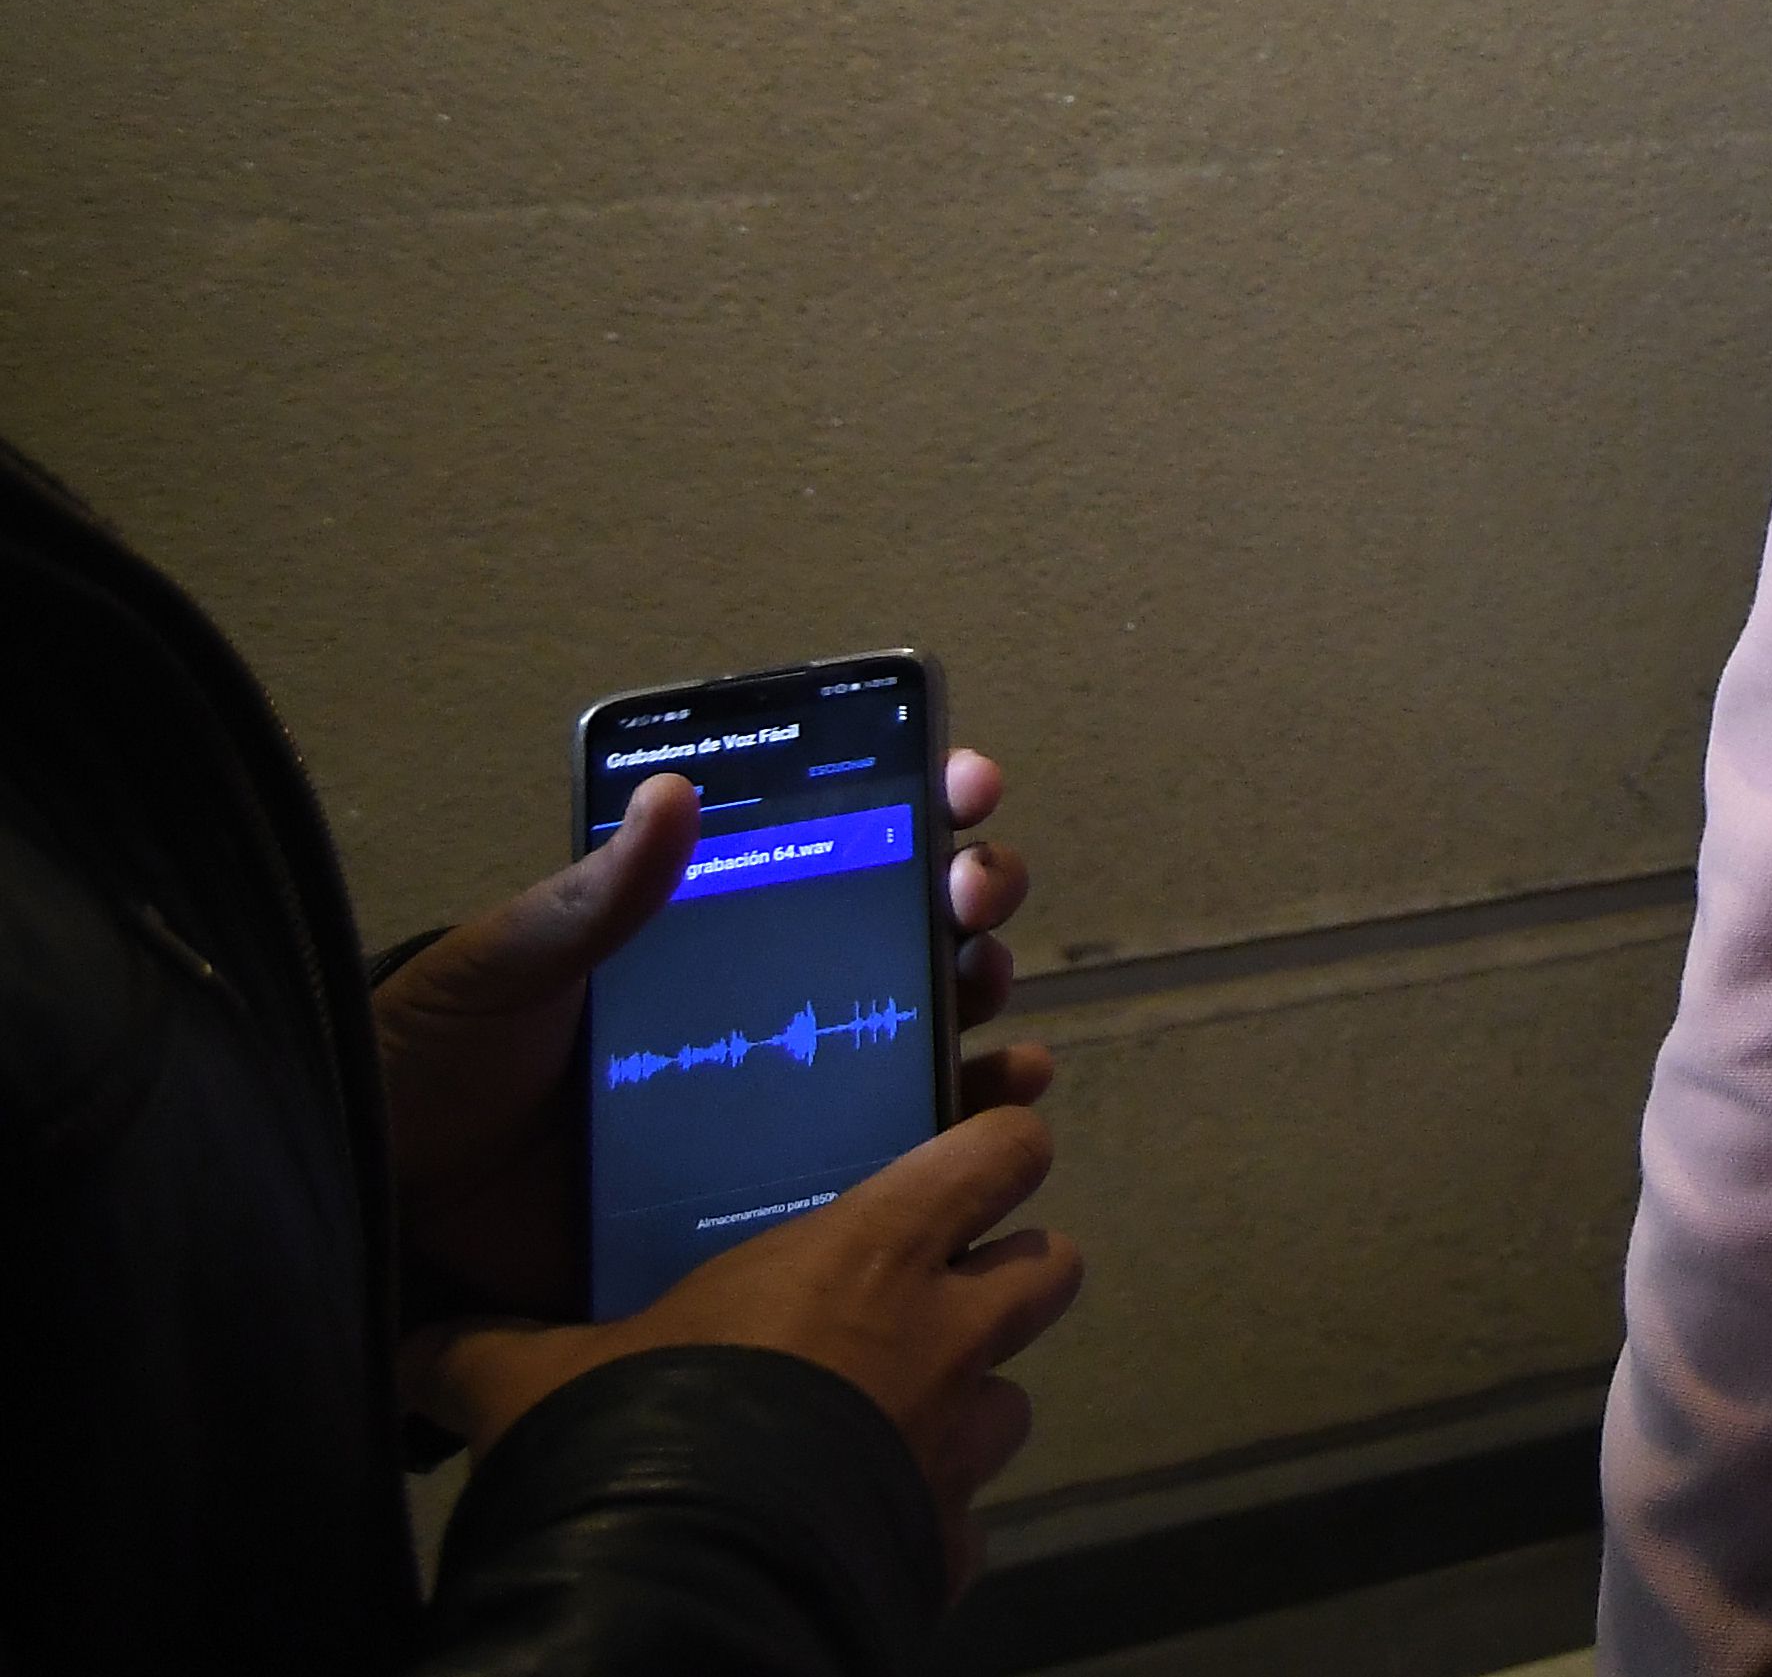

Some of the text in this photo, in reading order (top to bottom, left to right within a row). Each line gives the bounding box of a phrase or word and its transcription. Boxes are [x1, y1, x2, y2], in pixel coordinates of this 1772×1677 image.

[606, 723, 800, 770] Grabadora de Voz Fácil
[687, 840, 835, 880] grabación 64.wav
[787, 1197, 811, 1213] para
